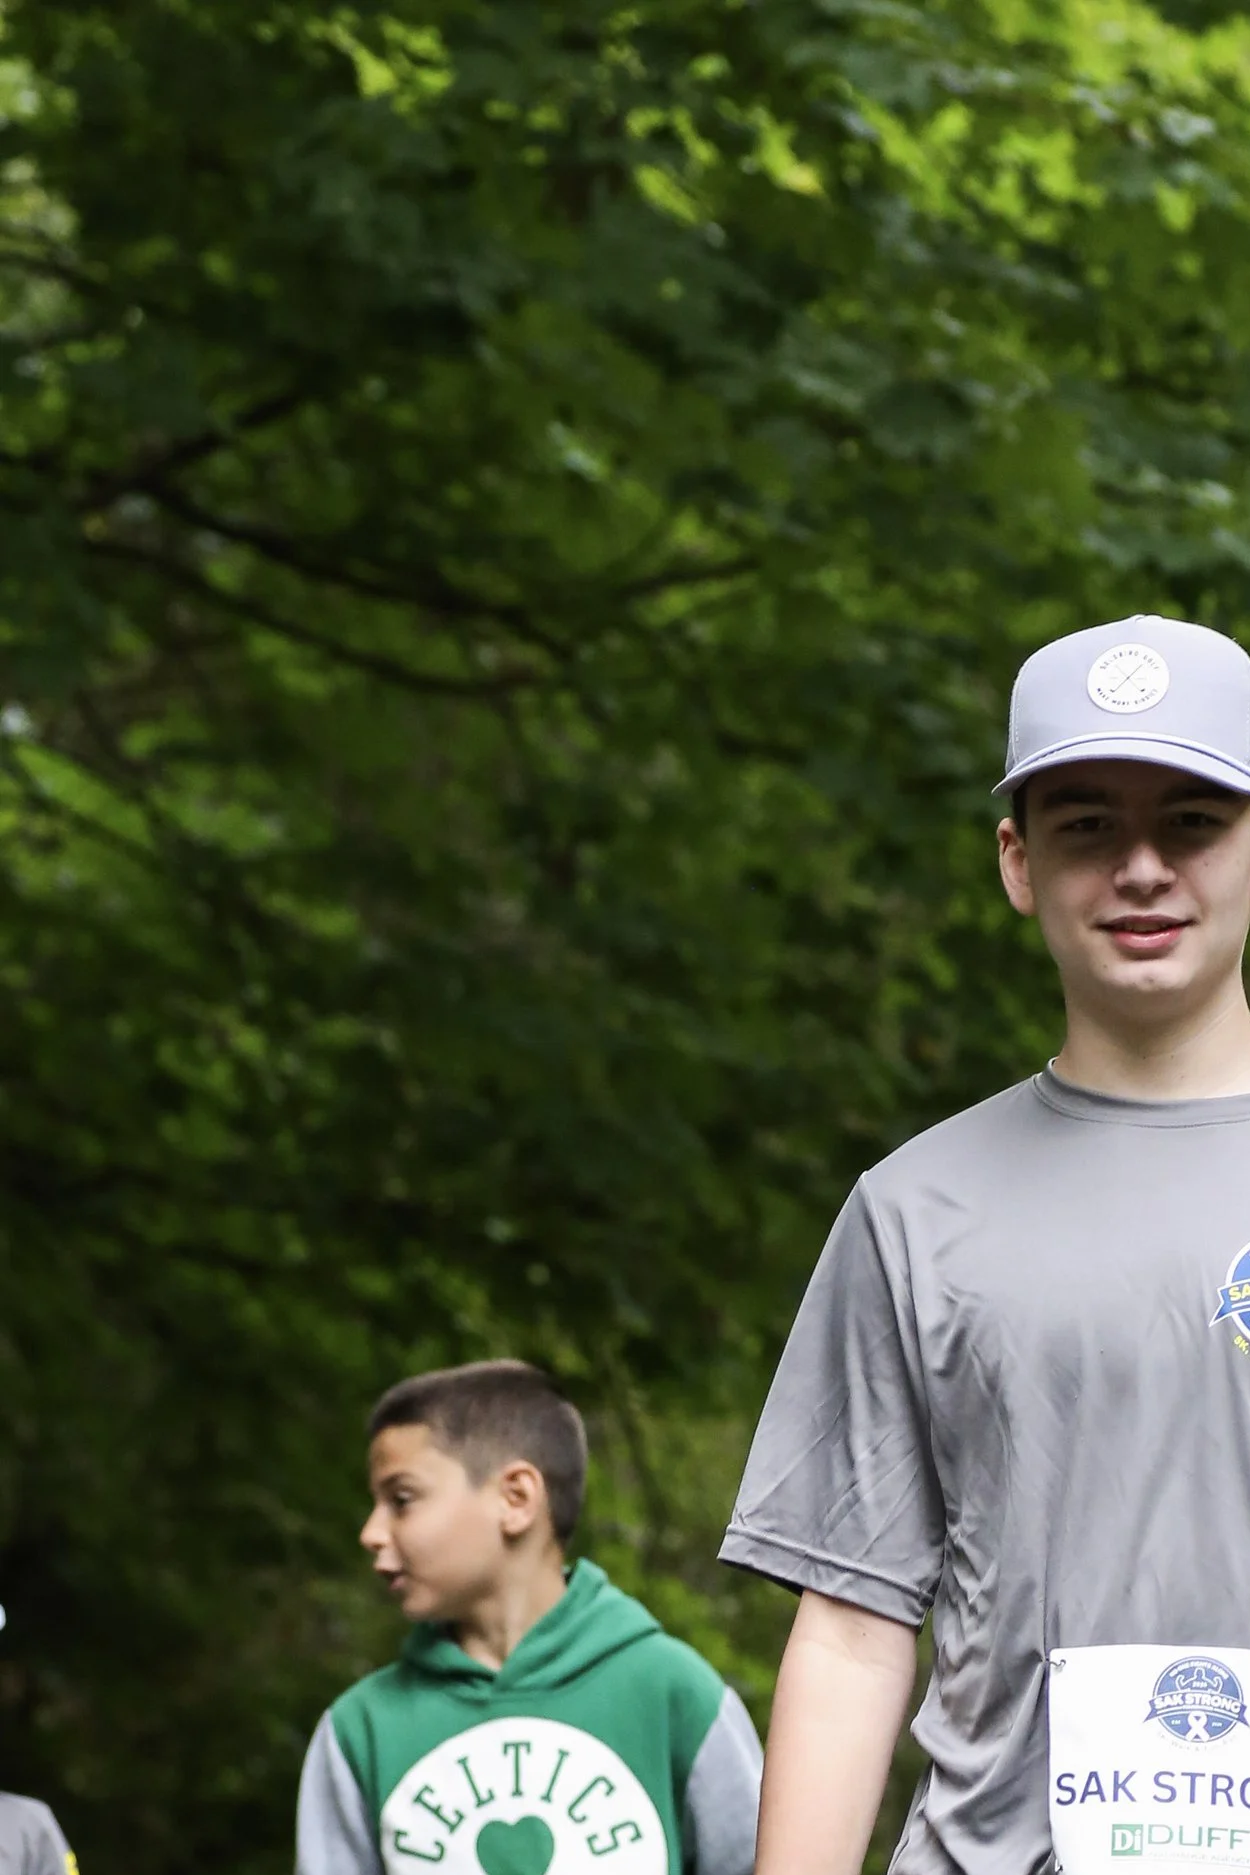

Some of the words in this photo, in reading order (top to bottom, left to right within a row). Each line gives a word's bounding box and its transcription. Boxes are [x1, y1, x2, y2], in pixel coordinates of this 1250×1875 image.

[1154, 1694, 1184, 1709] SAK
[1185, 1693, 1241, 1713] STRONG
[393, 1741, 643, 1864] CELTICS
[1055, 1769, 1138, 1807] SAK
[1113, 1828, 1142, 1851] Di
